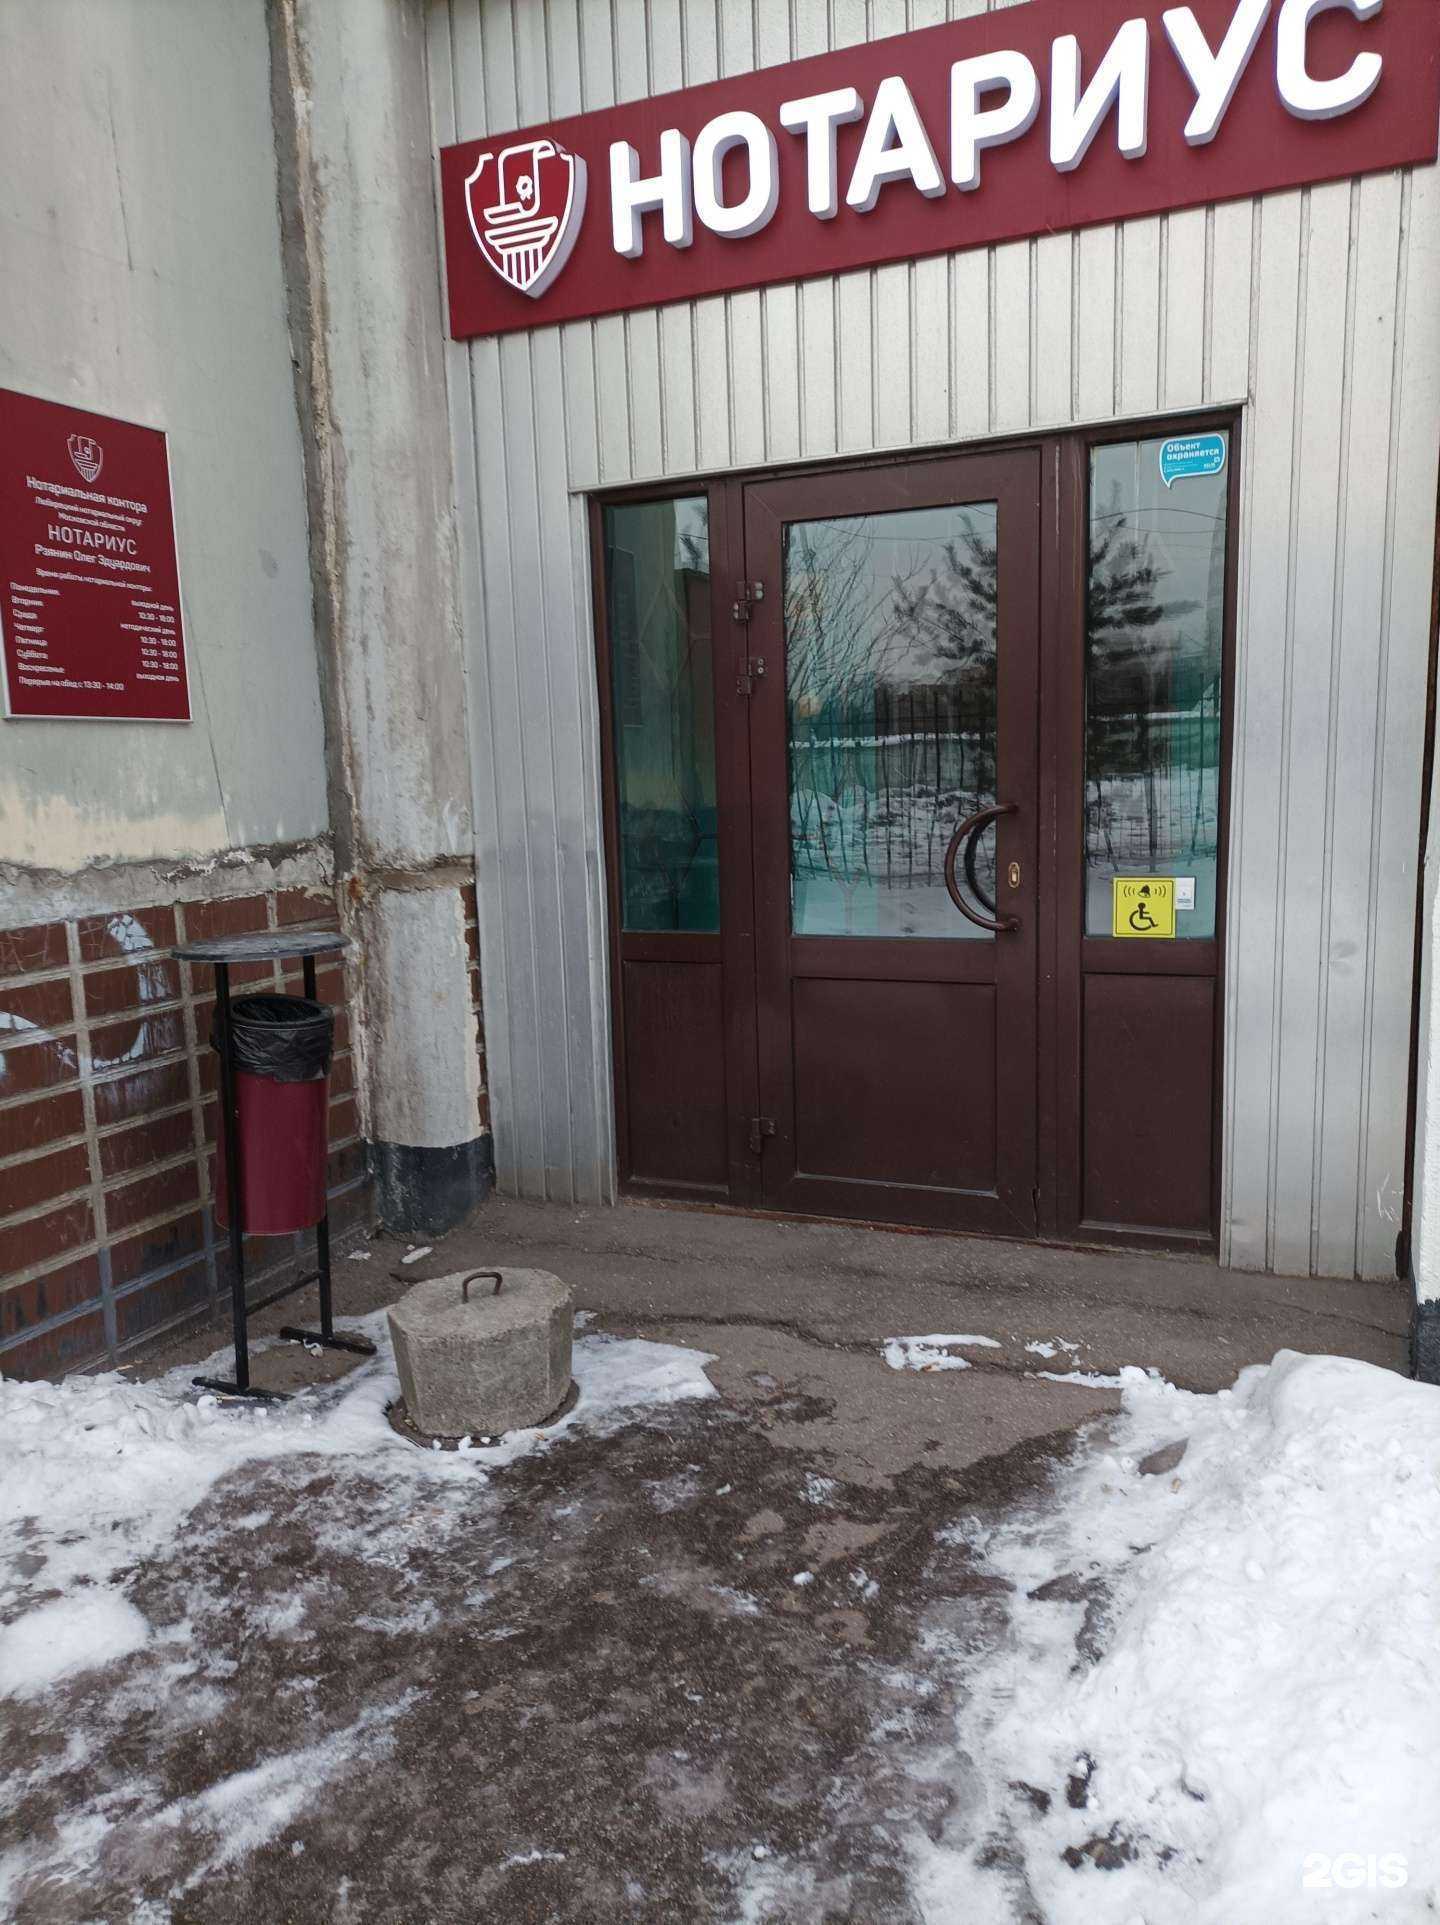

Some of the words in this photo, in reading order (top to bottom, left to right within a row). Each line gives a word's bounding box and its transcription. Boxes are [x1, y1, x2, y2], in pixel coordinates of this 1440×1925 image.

[611, 0, 1383, 258] НОТАРИУС
[1166, 442, 1200, 453] Объект
[1166, 449, 1219, 461] охраняется
[107, 497, 147, 513] контора
[48, 524, 137, 555] НОТАРИУС
